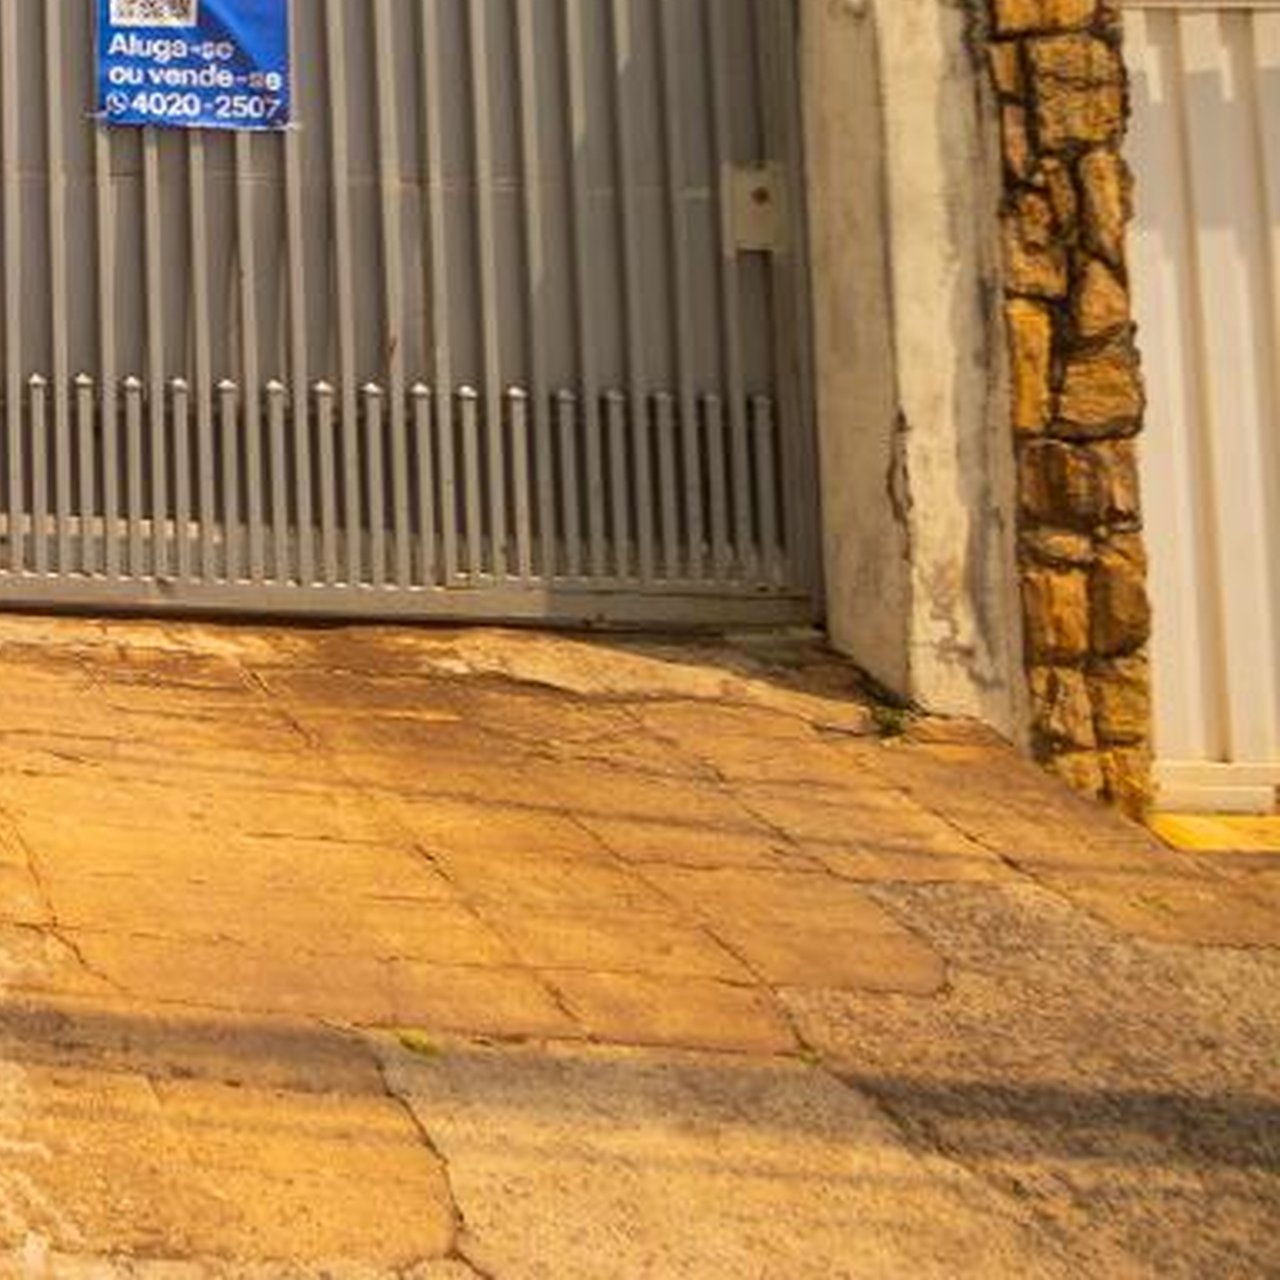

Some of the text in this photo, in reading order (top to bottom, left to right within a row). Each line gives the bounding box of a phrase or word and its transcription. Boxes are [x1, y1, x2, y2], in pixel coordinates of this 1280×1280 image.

[108, 34, 235, 63] Aluga-se
[108, 64, 282, 91] ou vende-se
[131, 91, 282, 118] 4020-2507
